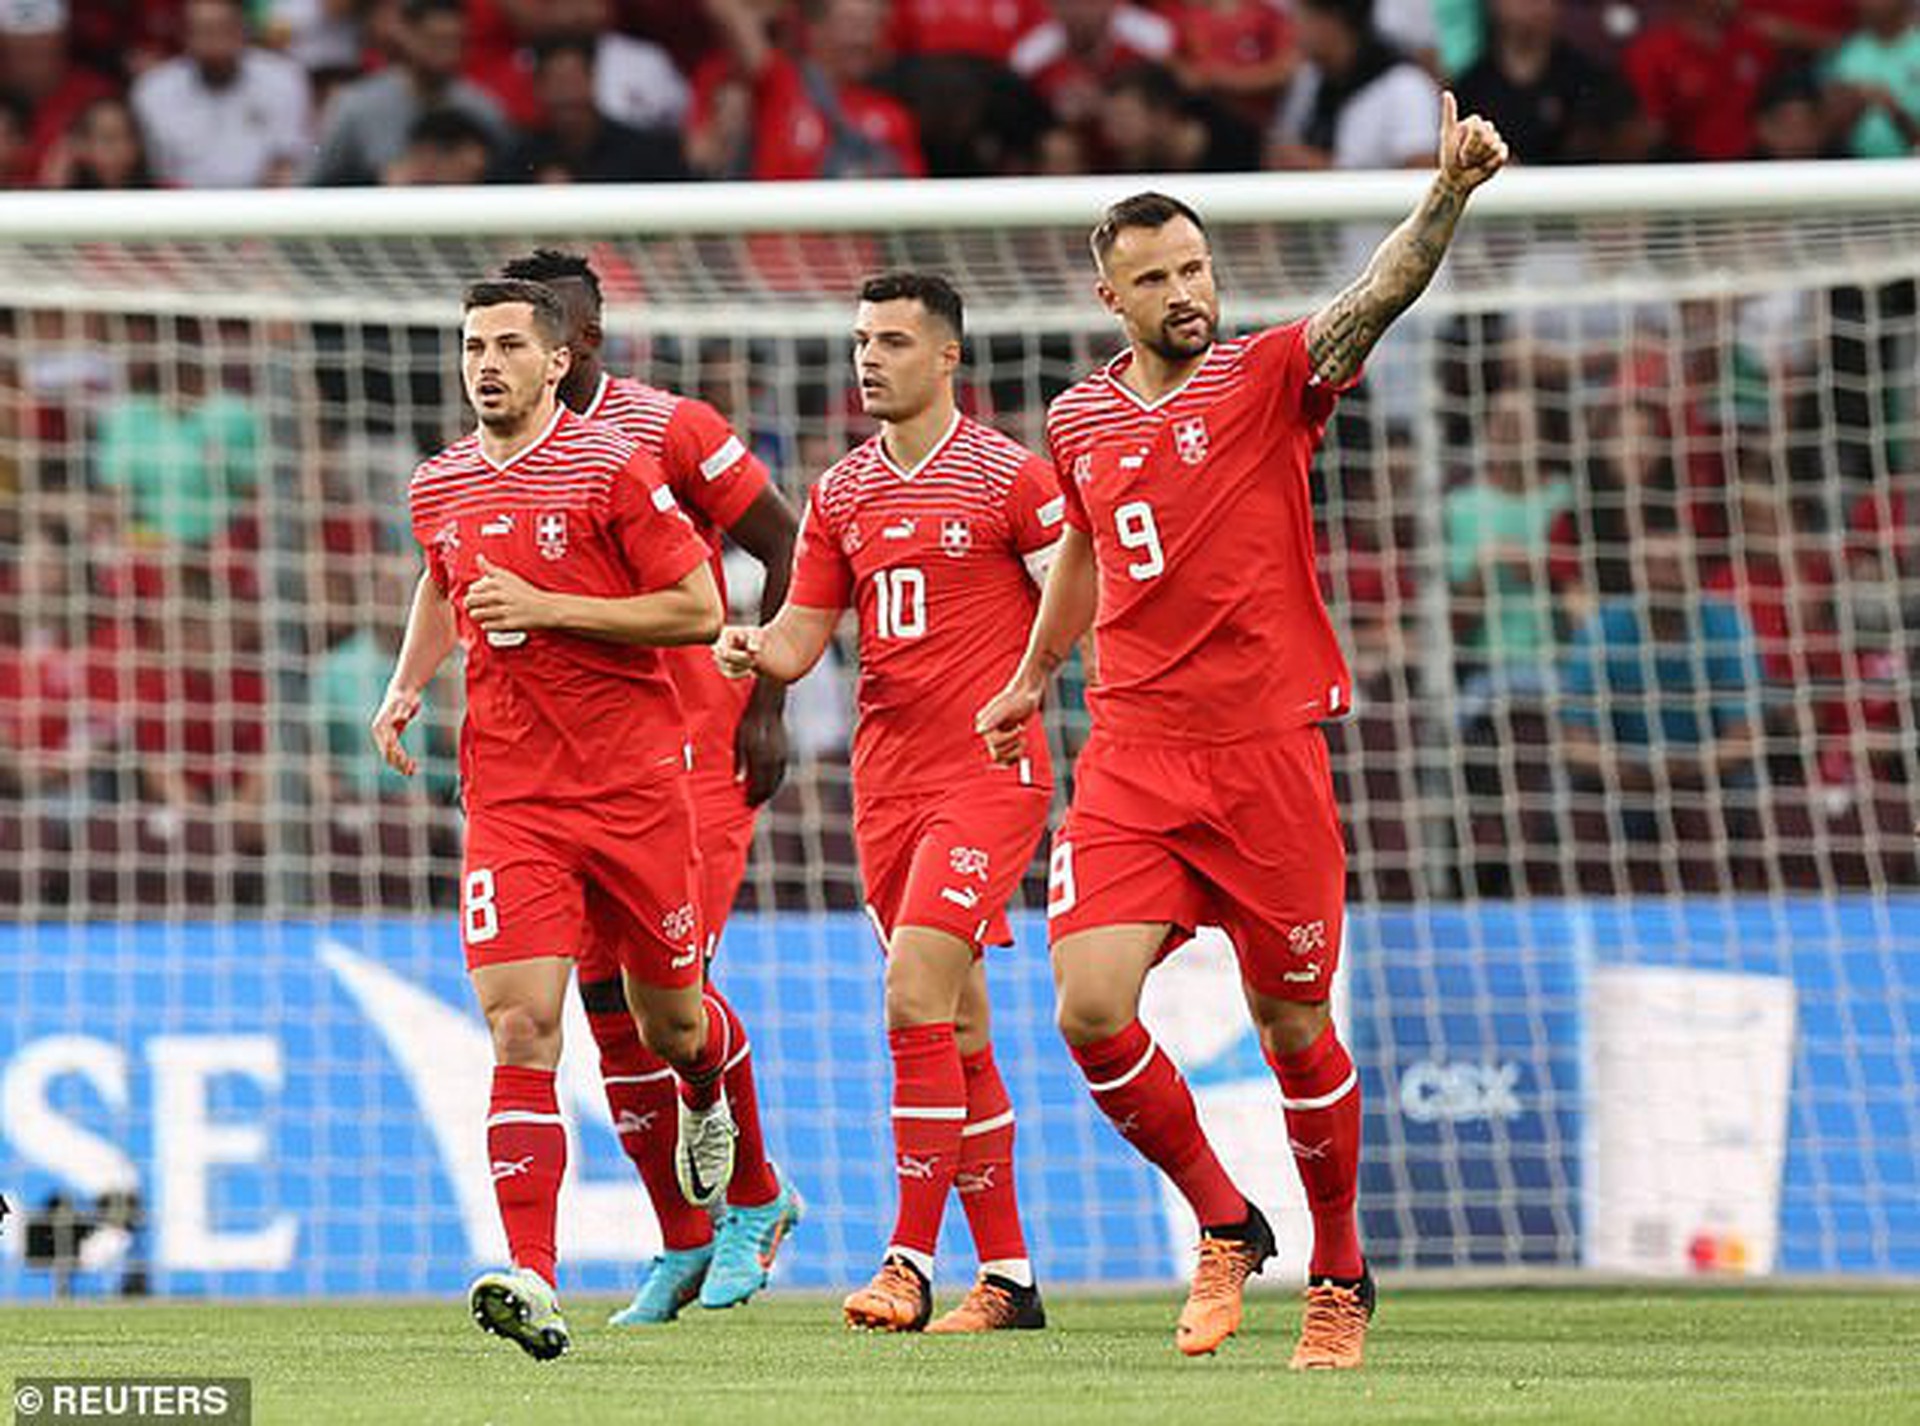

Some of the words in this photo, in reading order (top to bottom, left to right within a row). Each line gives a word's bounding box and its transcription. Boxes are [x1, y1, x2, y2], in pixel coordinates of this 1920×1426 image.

[1114, 501, 1165, 581] 9
[873, 567, 926, 639] 10
[465, 868, 499, 945] 8
[1048, 841, 1076, 919] 9
